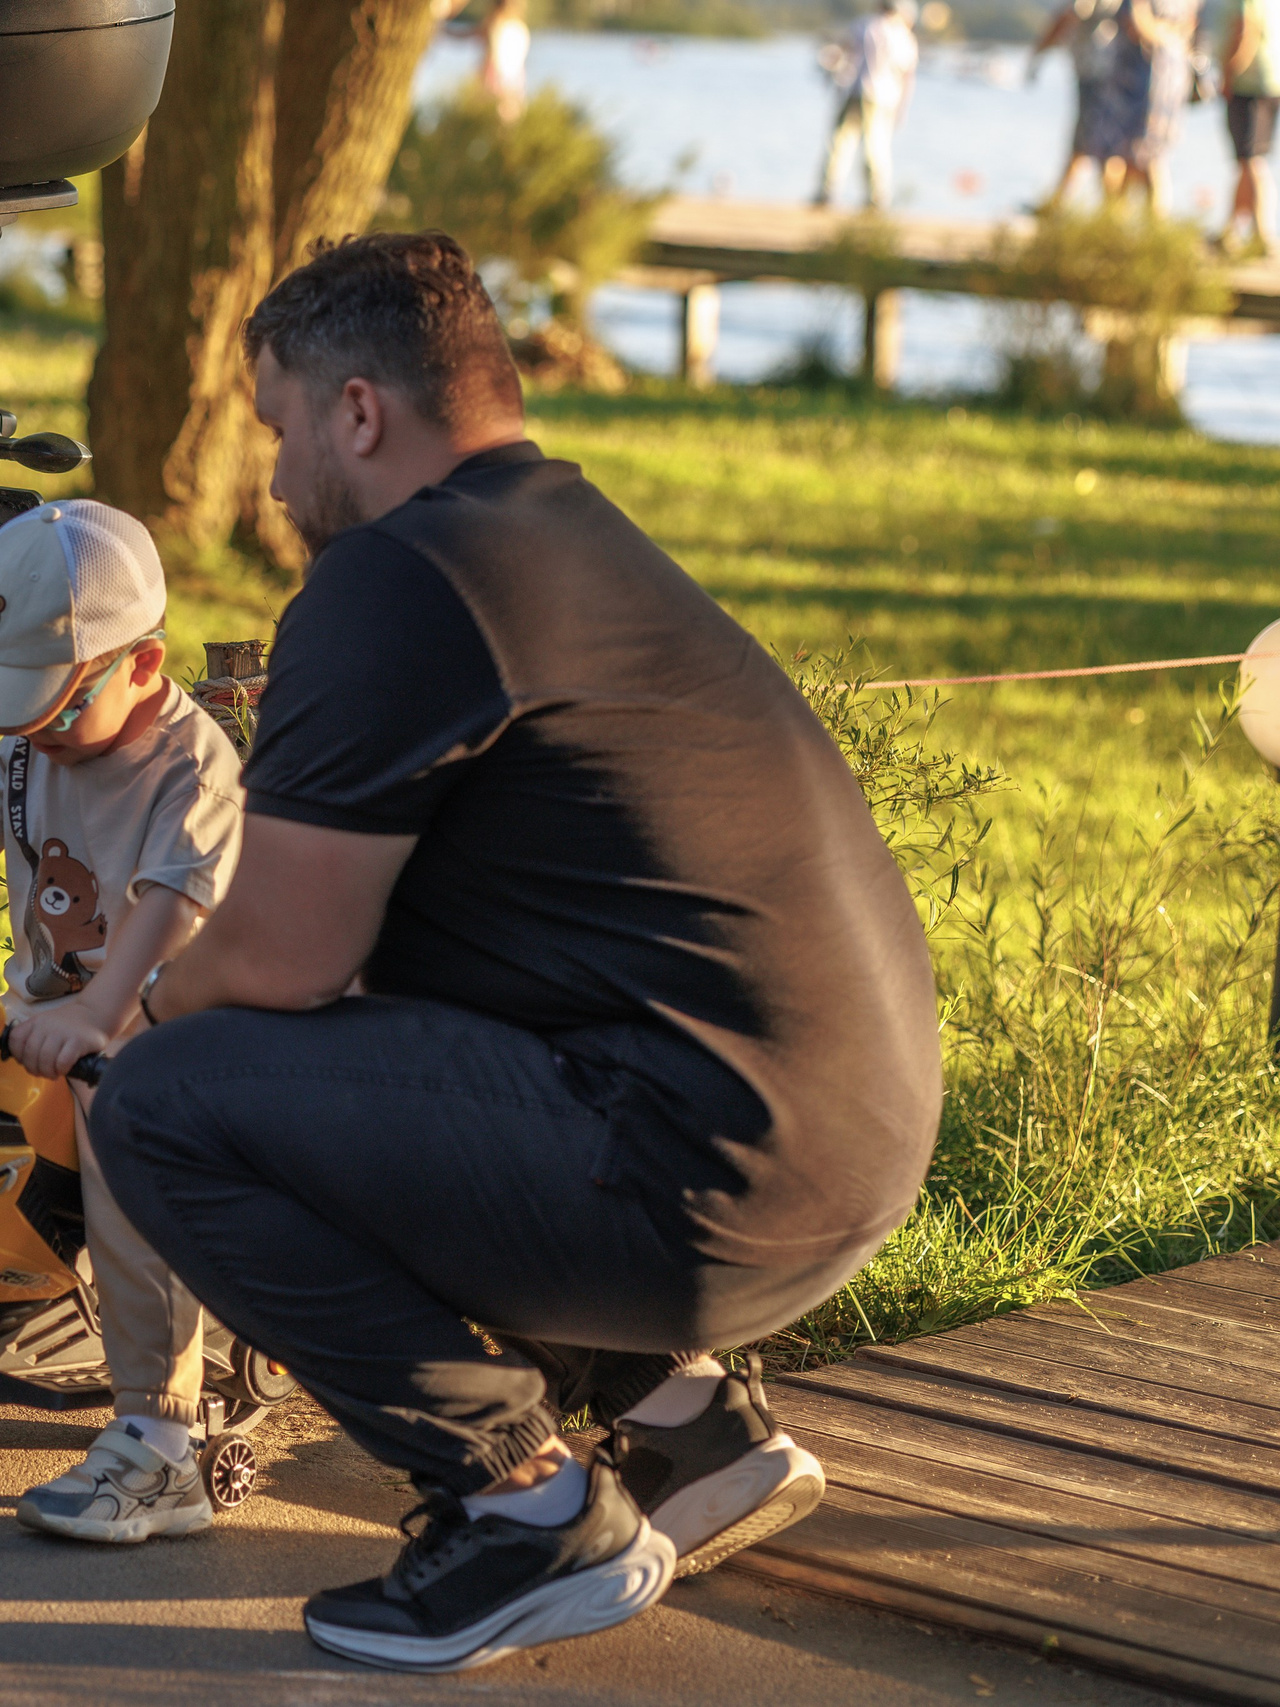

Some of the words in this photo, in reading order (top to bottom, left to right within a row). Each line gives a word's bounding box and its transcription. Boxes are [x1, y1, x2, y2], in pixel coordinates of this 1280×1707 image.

[14, 736, 28, 756] AY
[11, 758, 26, 791] WILD
[10, 805, 23, 838] STAY
